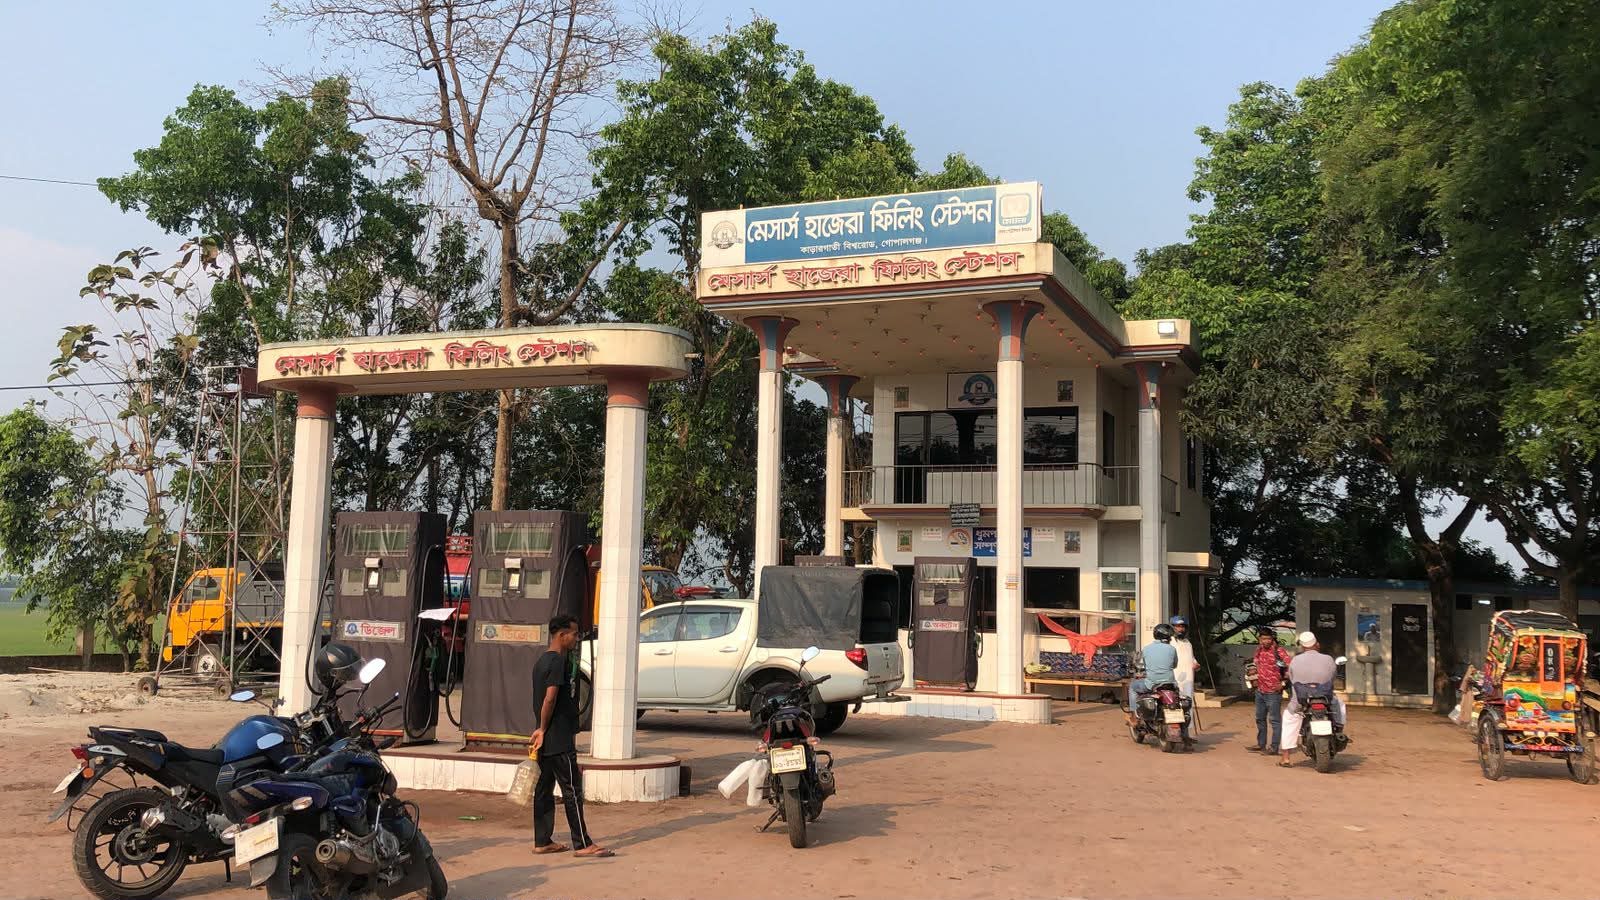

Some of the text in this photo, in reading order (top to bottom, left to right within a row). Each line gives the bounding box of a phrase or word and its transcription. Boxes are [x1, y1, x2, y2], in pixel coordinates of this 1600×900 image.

[747, 211, 799, 242] মেসার্স
[804, 211, 865, 239] হাজেরা
[870, 198, 925, 232] ফিলিং
[931, 196, 993, 227] স্টেশন
[707, 250, 1024, 290] মেসার্স হাজেরা ফিলিং স্টেশন
[275, 337, 599, 376] মেসার্স হাজেরা ফিলিং স্টেশন
[360, 623, 396, 637] ডিজেল
[501, 624, 539, 640] ডিজেল
